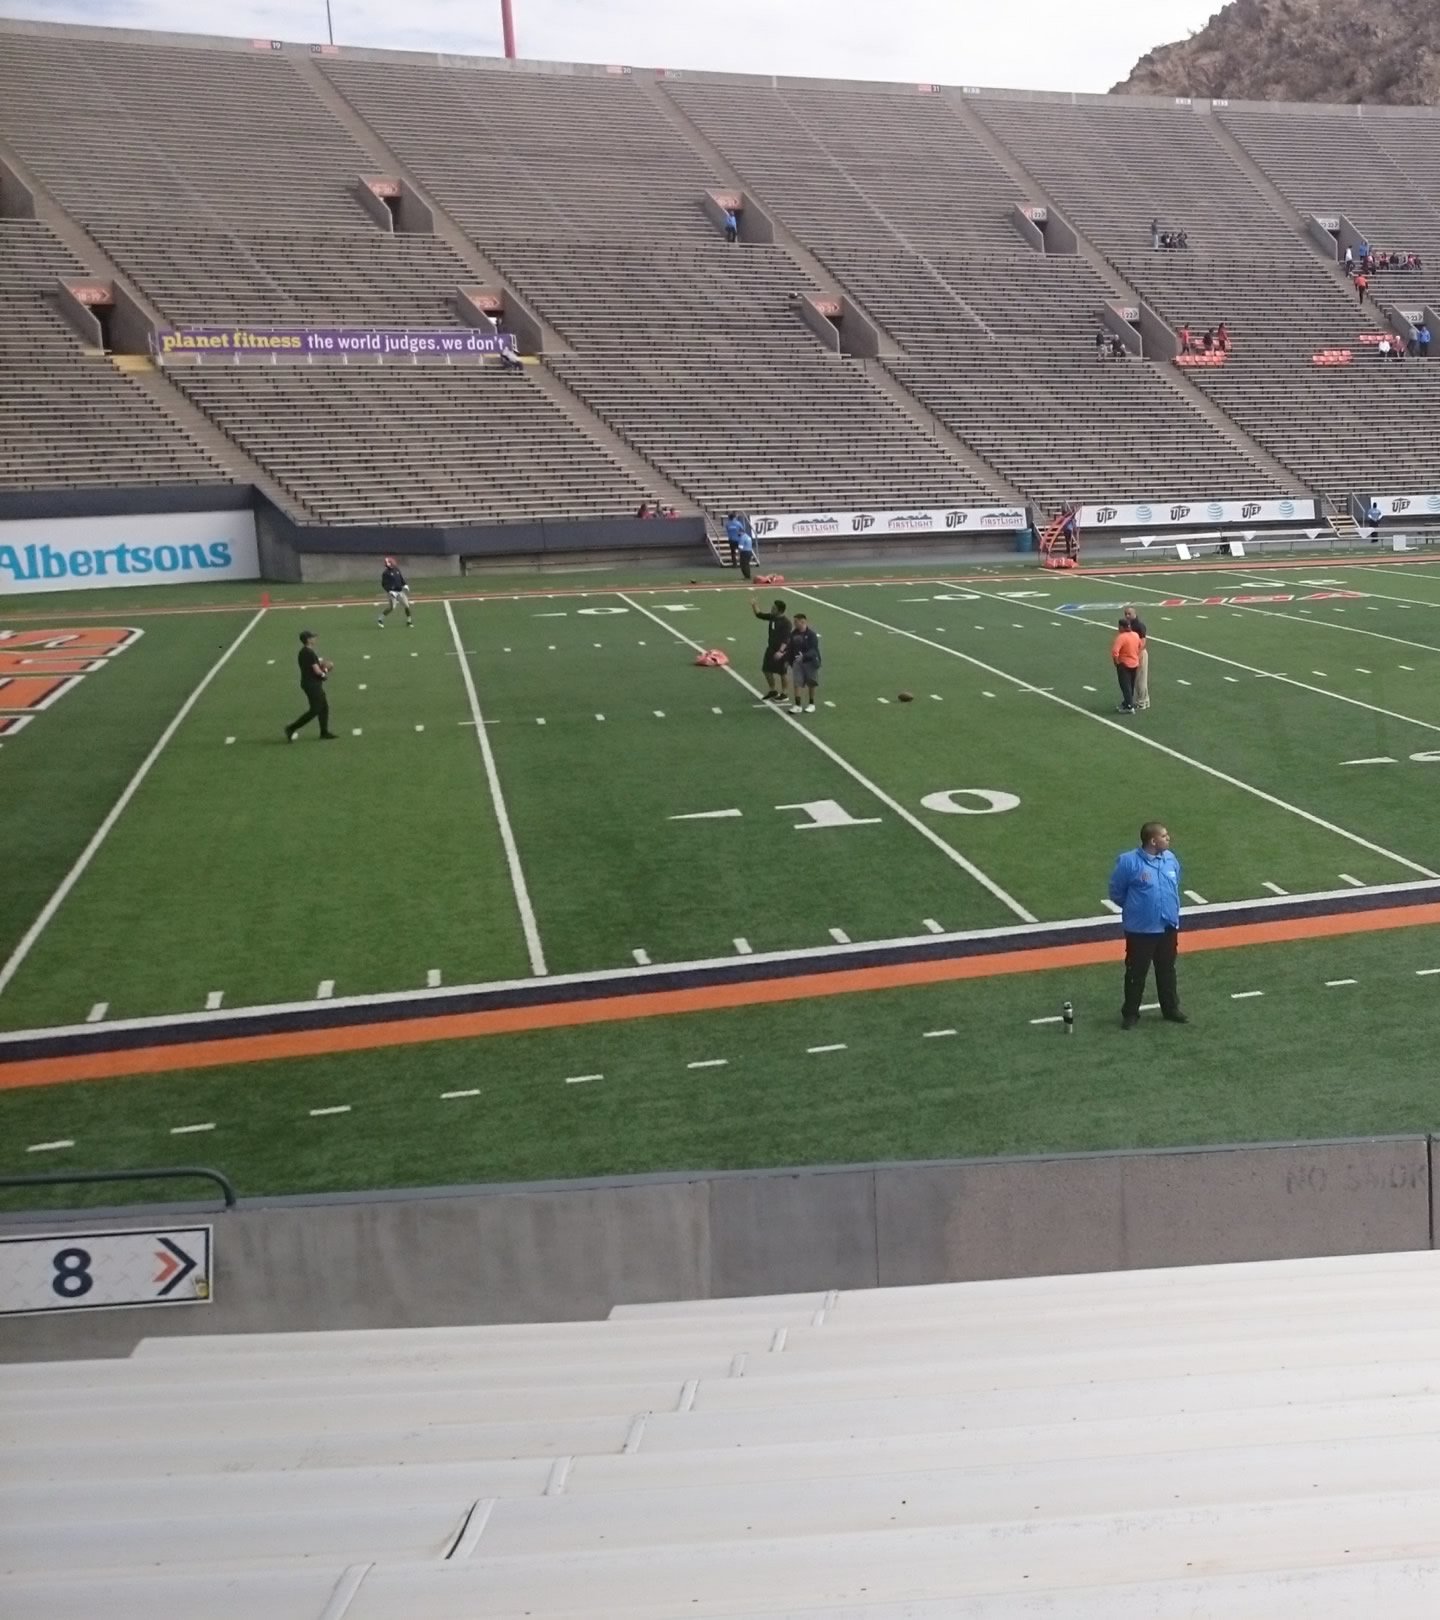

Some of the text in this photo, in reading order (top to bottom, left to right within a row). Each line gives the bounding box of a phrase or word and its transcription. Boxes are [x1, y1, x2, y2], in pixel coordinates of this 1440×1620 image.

[163, 332, 230, 352] planet
[233, 332, 302, 350] fitness
[308, 334, 334, 349] the
[337, 335, 381, 350] world
[384, 334, 440, 352] judges.
[1096, 503, 1262, 524] UTEP UTEP UTEP
[1392, 498, 1411, 513] UTEP
[754, 517, 779, 535] UTEP
[852, 514, 876, 532] UTEP
[945, 511, 969, 529] UTEP
[0, 542, 233, 581] Albertsons
[774, 788, 1021, 830] 10
[53, 1247, 94, 1298] 8
